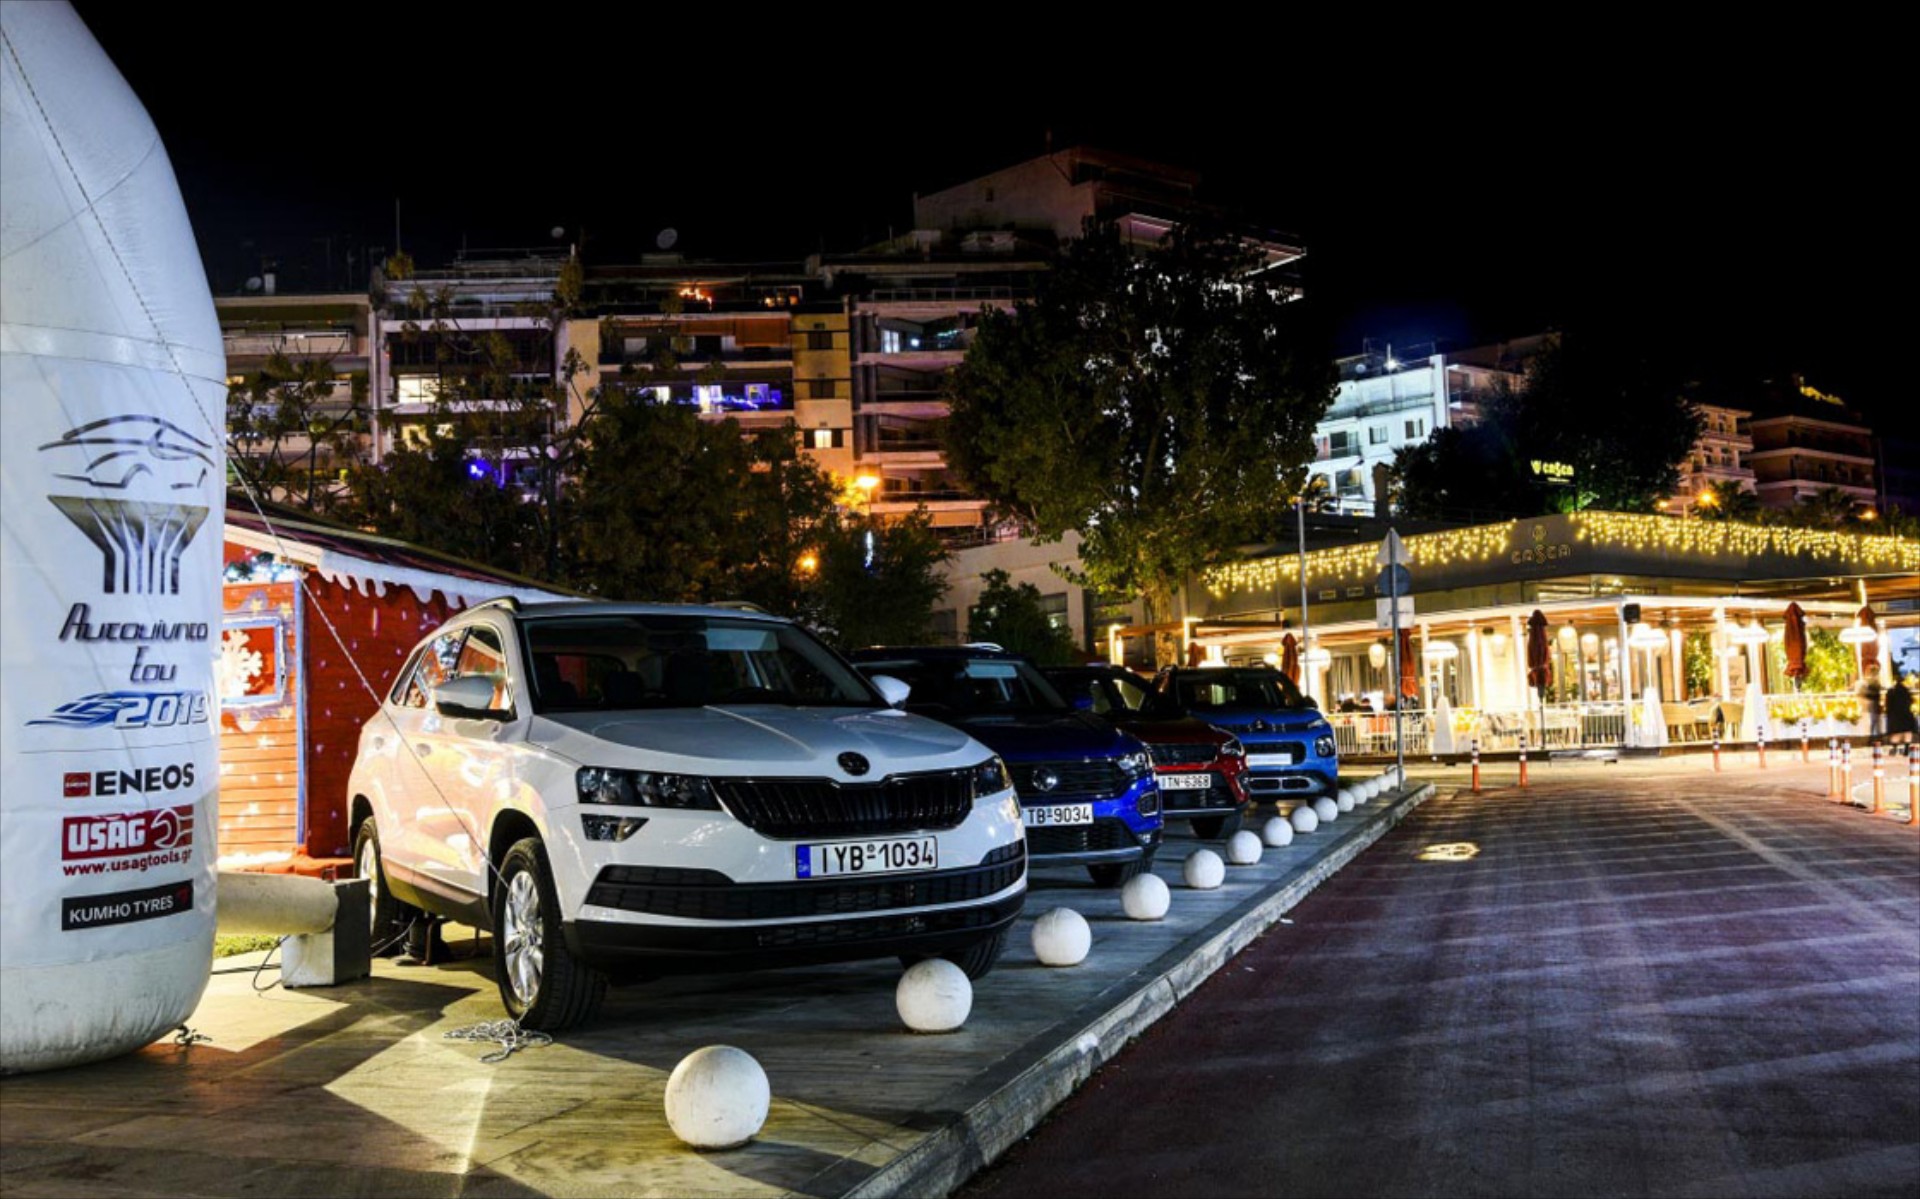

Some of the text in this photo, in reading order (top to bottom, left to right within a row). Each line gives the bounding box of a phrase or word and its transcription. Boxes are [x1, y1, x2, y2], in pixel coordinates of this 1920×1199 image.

[113, 694, 209, 730] 2019
[95, 762, 195, 796] ENEOS
[68, 818, 146, 853] USAG
[63, 847, 193, 876] www.usagtools.gr
[69, 895, 175, 924] KUMHO TYRES
